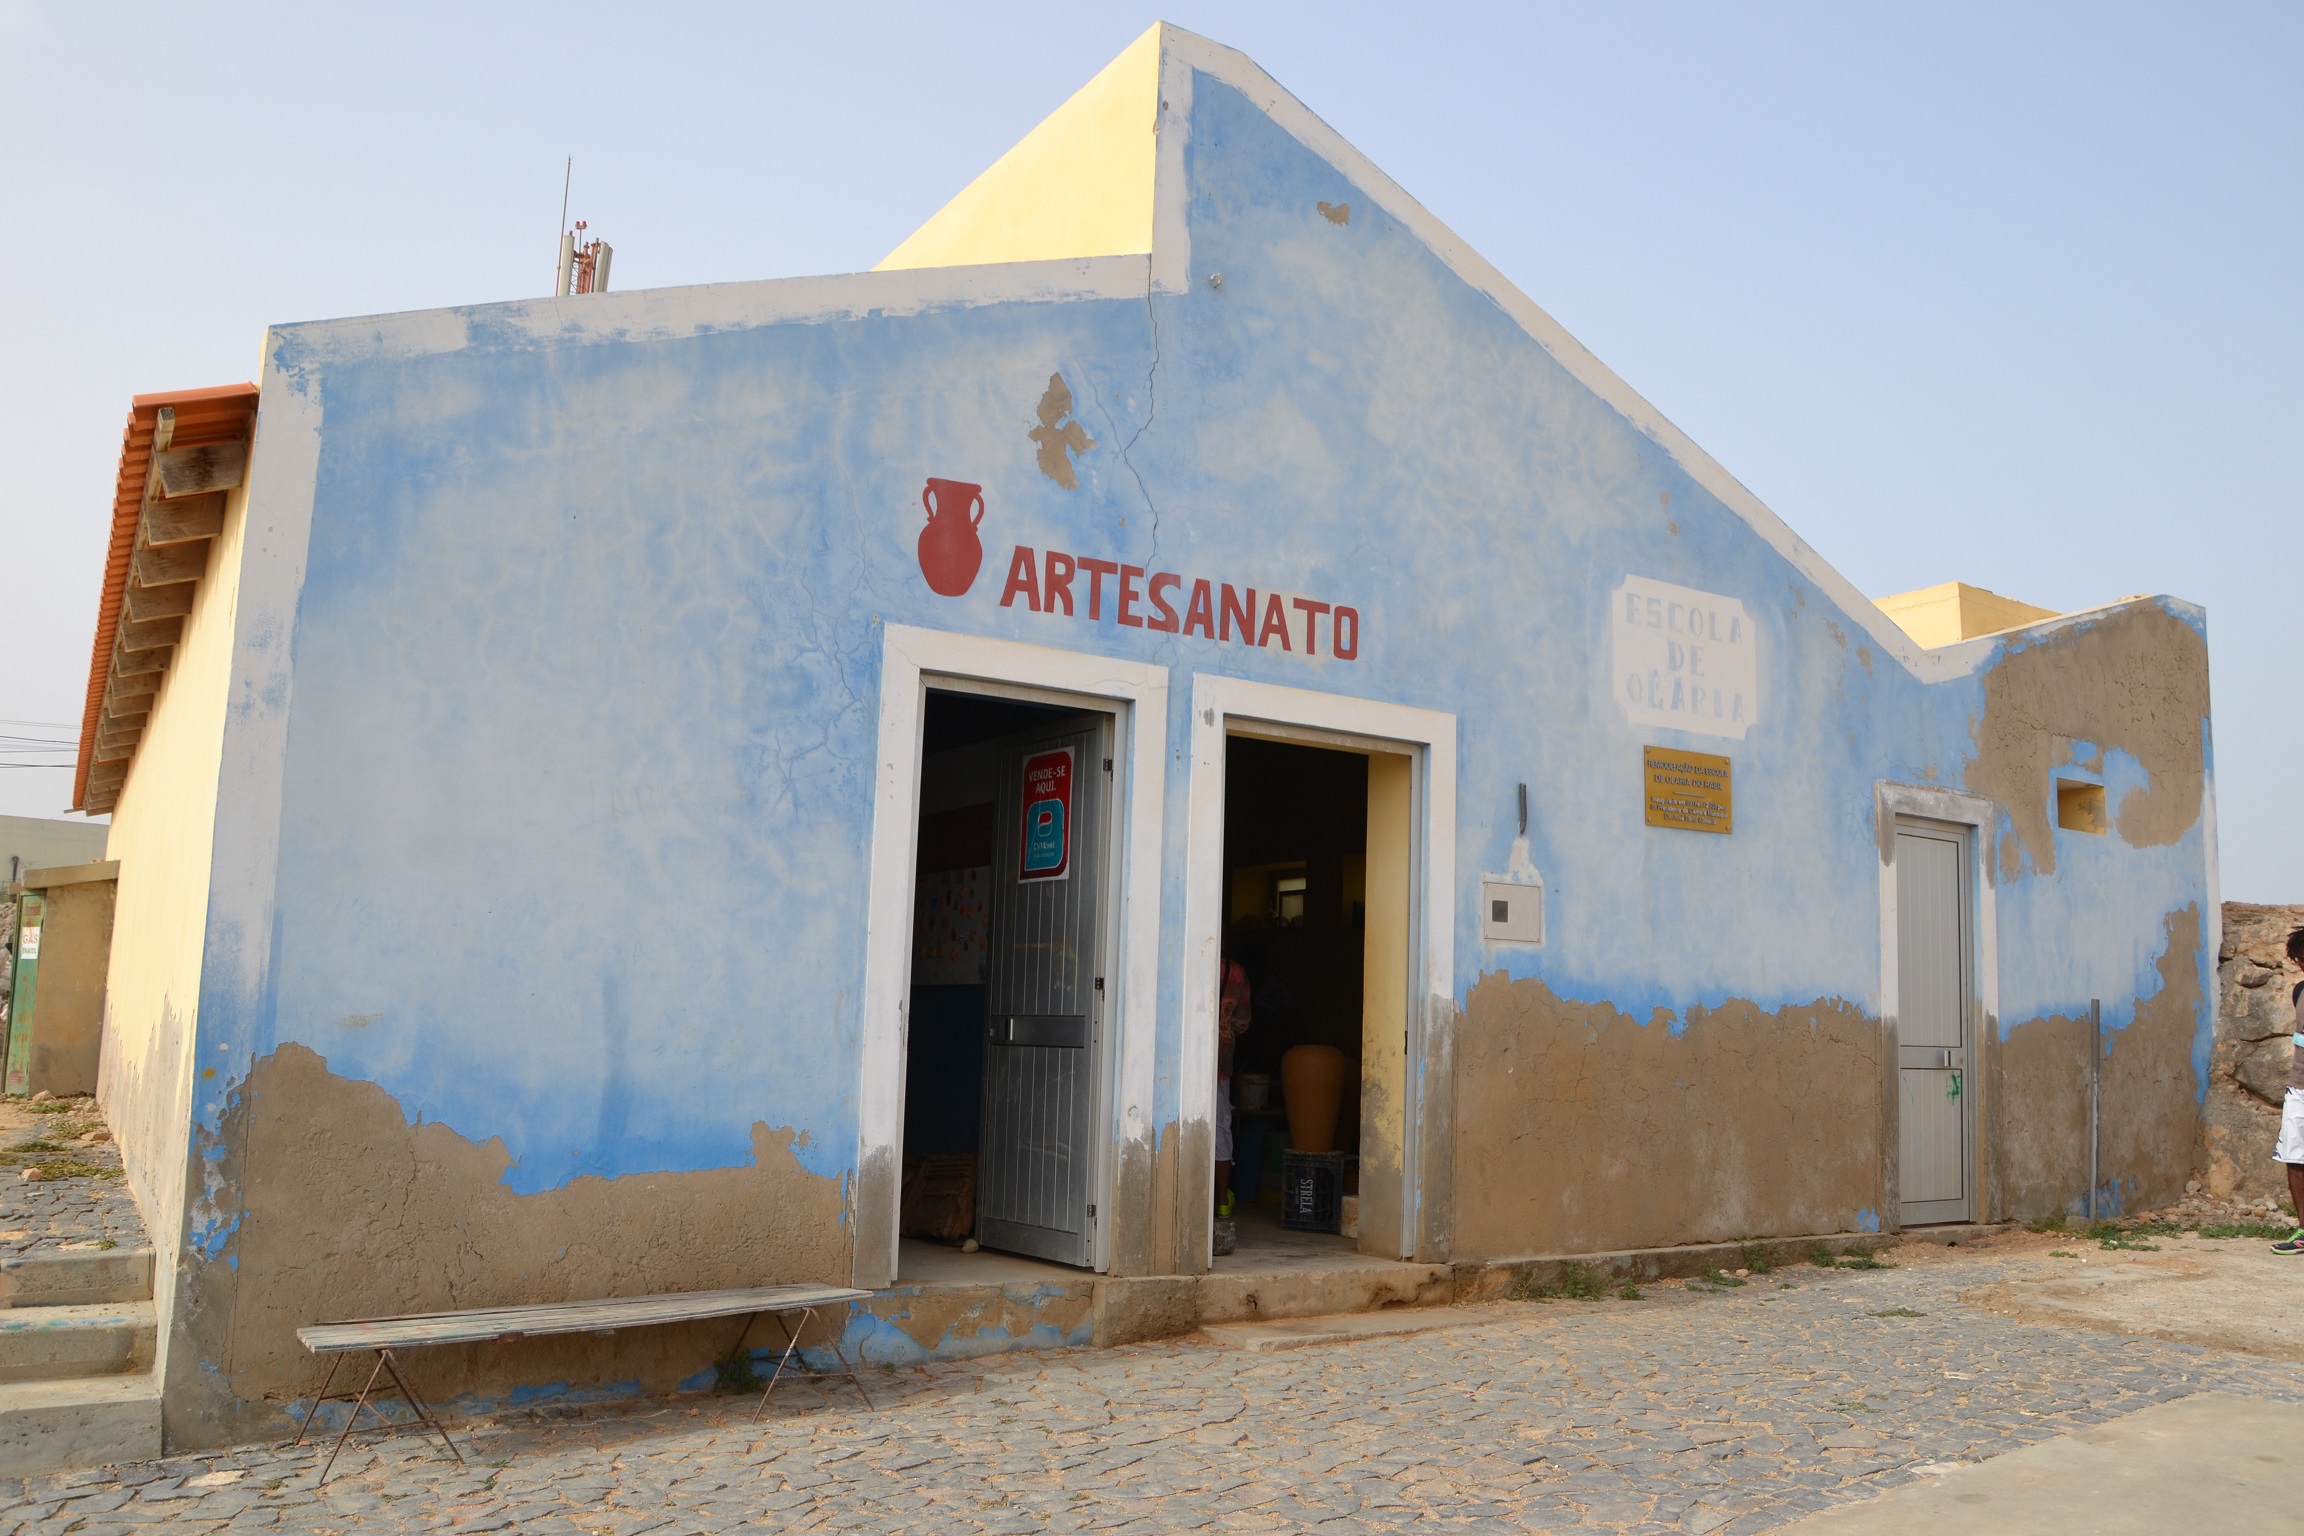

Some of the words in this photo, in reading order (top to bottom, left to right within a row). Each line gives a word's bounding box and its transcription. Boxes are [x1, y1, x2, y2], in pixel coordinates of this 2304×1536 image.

[1000, 545, 1358, 660] ARTESANATO
[1626, 592, 1743, 646] ESCOLA
[1667, 638, 1704, 677] DE
[1626, 669, 1744, 723] OLARIA
[1028, 765, 1066, 782] VENDE-SE
[1648, 760, 1694, 773] REMODELAÇÃO
[1695, 766, 1705, 774] DA
[1705, 768, 1728, 777] ESCOLA
[1655, 773, 1663, 783] DE
[1665, 775, 1690, 786] OLARIA
[1692, 779, 1702, 788] DO
[1036, 780, 1057, 795] AQUI.
[1300, 1179, 1314, 1214] STRELA
